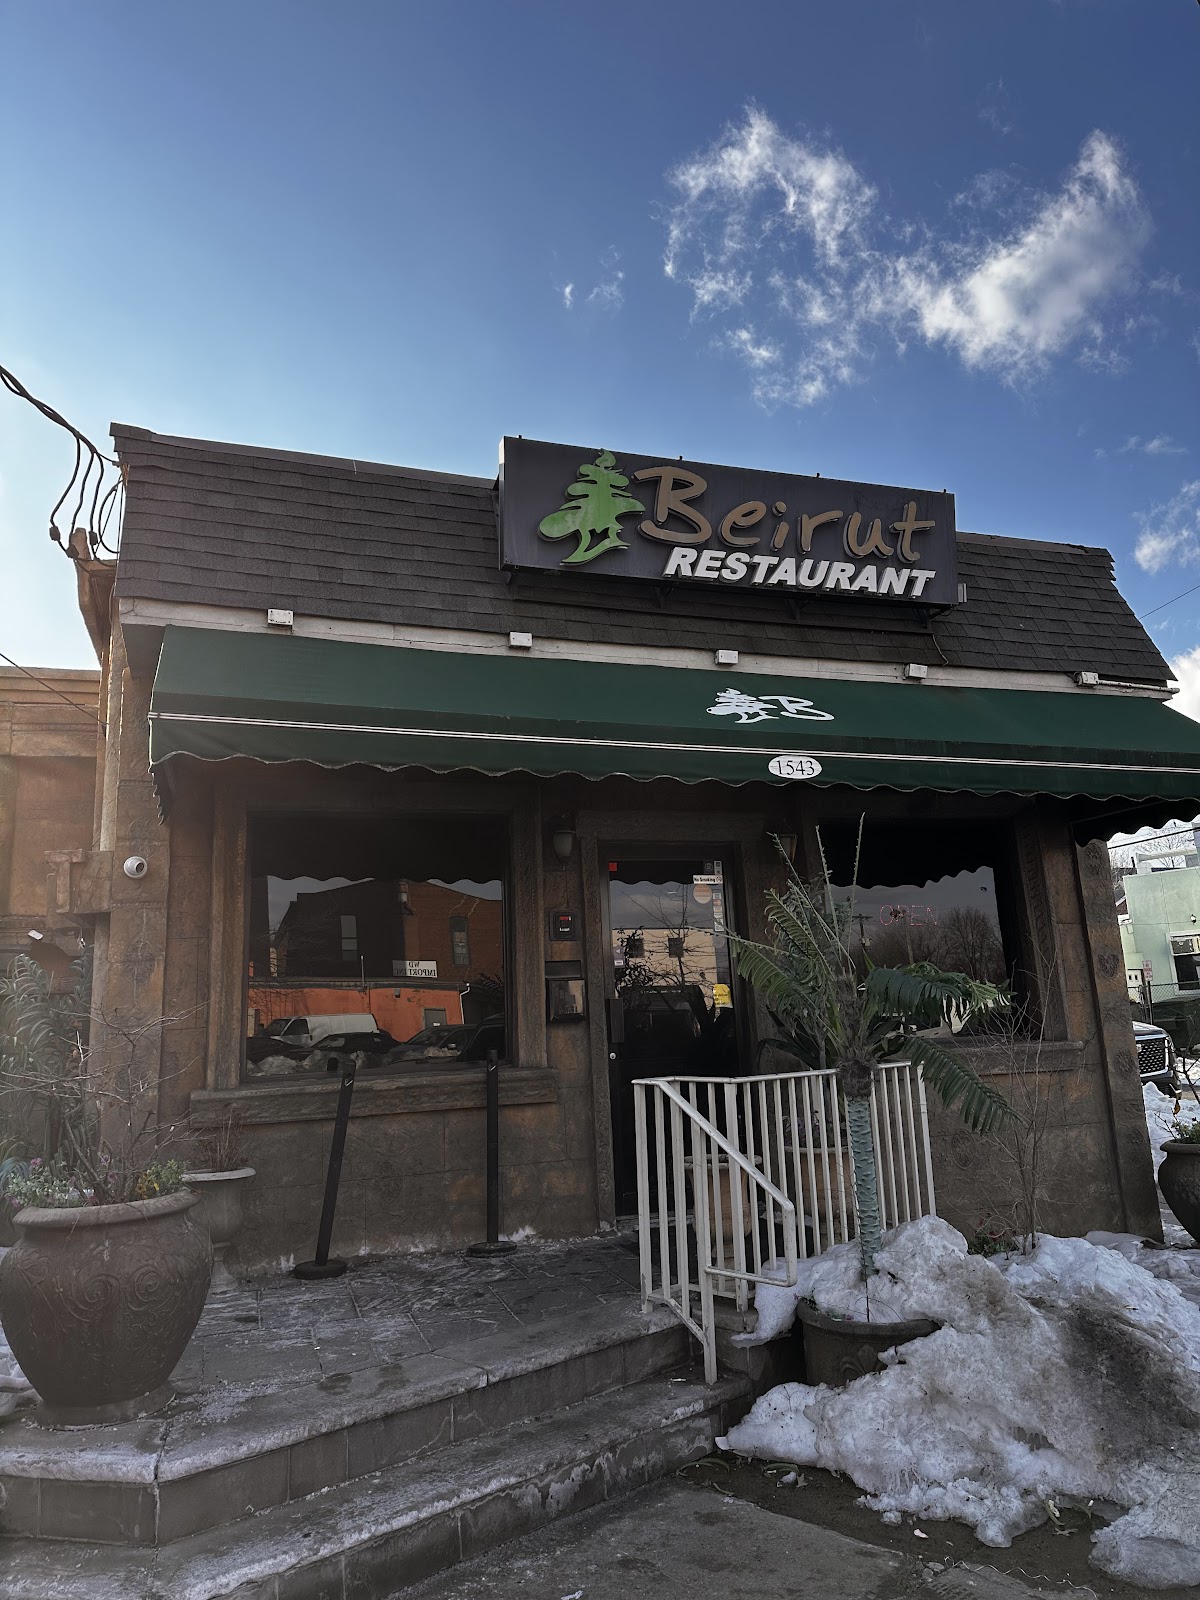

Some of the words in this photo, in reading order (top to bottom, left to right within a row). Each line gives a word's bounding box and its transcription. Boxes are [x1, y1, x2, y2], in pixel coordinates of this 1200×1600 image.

[631, 466, 936, 563] Beirut
[662, 546, 936, 598] RESTAURANT
[776, 760, 815, 776] 1543
[880, 904, 938, 926] OPEN
